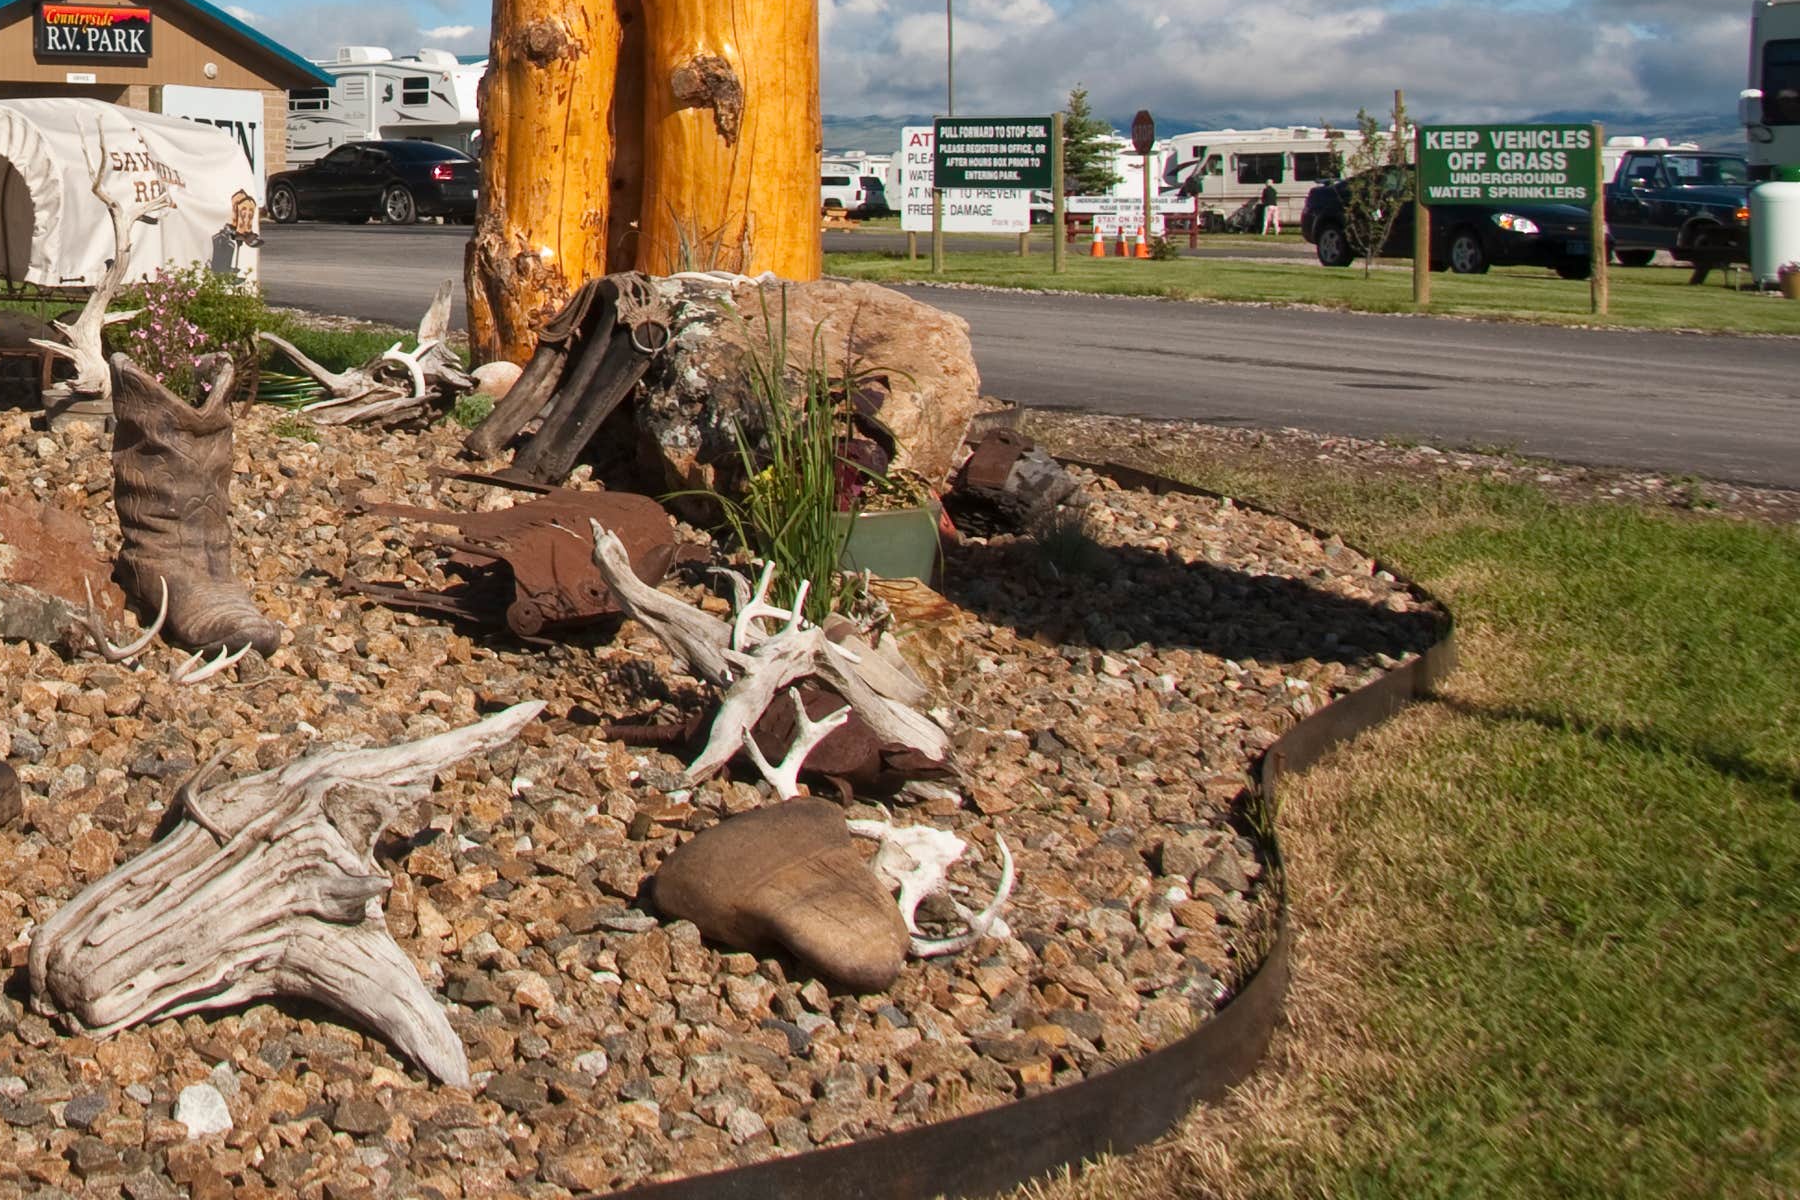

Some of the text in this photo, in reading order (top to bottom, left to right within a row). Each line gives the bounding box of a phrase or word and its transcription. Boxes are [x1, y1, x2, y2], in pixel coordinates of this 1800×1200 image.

[45, 8, 114, 34] Countryside
[46, 26, 147, 53] R.V. PARK
[940, 126, 959, 138] PULL
[959, 126, 994, 138] FORWARD
[995, 126, 1005, 138] TO
[1006, 126, 1026, 138] STOP
[1425, 129, 1591, 150] KEEP VEHICLES
[939, 144, 965, 154] PLEASE
[999, 144, 1007, 153] IN
[1035, 144, 1046, 153] OR
[945, 157, 1041, 167] AFTER HOURS BOX PRIOR TO
[1447, 151, 1568, 171] OFF GRASS
[909, 170, 935, 182] WATE
[964, 170, 998, 180] ENTERING
[1450, 172, 1567, 184] UNDERGROUND
[908, 187, 920, 199] AT
[976, 189, 1022, 199] PREVENT
[1429, 186, 1587, 199] WATER SPRINKLERS
[908, 204, 993, 216] FREEE DAMAGE
[1097, 216, 1116, 224] STAY
[1133, 216, 1160, 224] RODS
